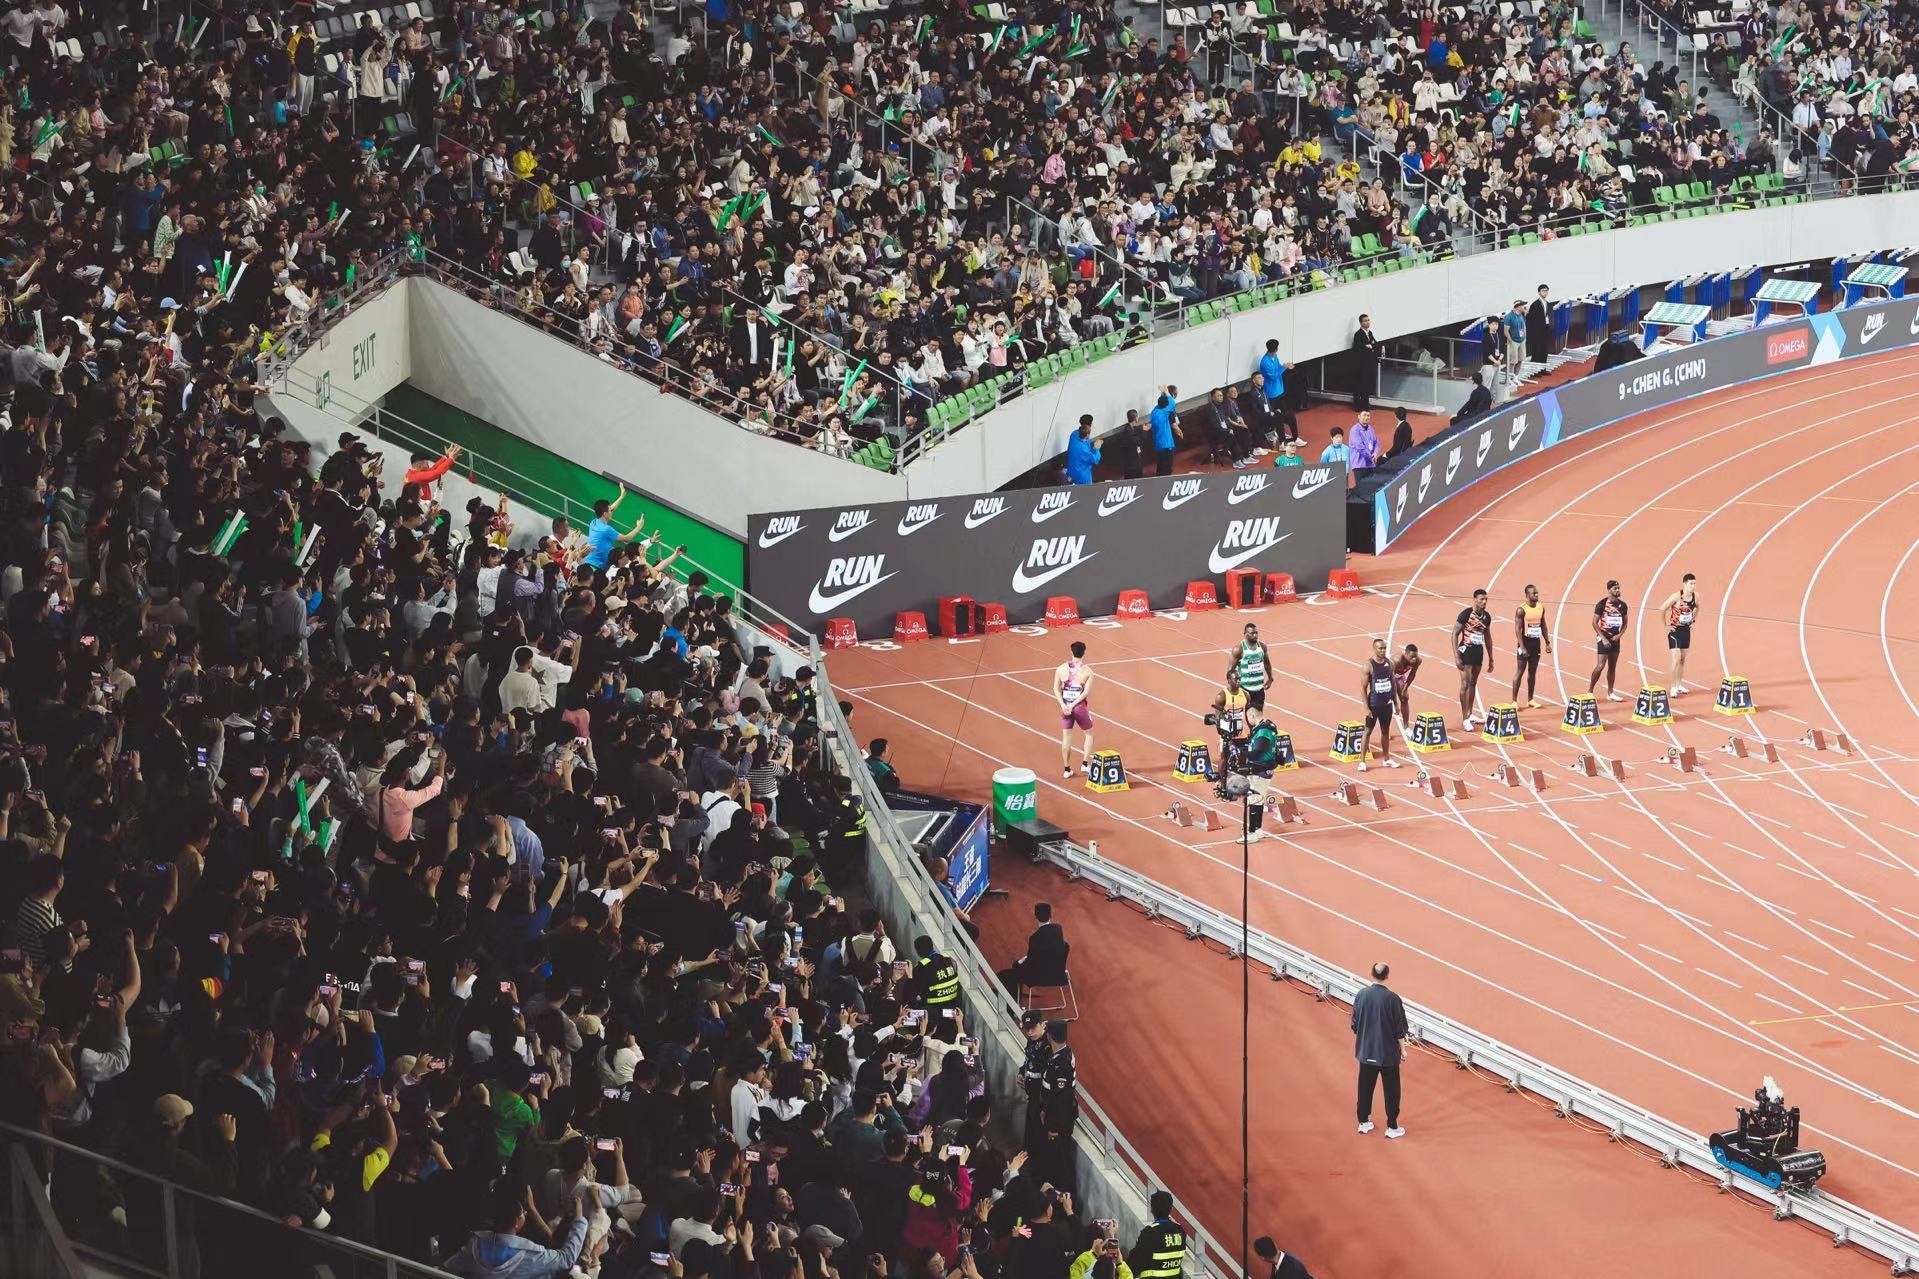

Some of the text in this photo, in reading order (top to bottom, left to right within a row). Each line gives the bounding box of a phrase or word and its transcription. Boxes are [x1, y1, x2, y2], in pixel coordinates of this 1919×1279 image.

[1865, 312, 1885, 330] RUN
[1778, 340, 1806, 354] OMEGA
[353, 332, 376, 381] EXIT
[1619, 383, 1626, 400] 9
[1633, 370, 1661, 395] CHEN
[1662, 368, 1673, 386] G.
[1675, 359, 1706, 386] (CHN)
[1512, 413, 1526, 435] RUN
[1236, 474, 1267, 490] RUN
[1300, 468, 1330, 484] RUN
[1106, 486, 1137, 503] RUN
[1171, 479, 1201, 496] RUN
[972, 497, 1005, 515] RUN
[1039, 491, 1071, 509] RUN
[836, 510, 870, 528] RUN
[906, 503, 938, 521] RUN
[767, 516, 801, 534] RUN
[1222, 516, 1281, 549] RUN
[1026, 535, 1086, 568] RUN
[824, 554, 886, 588] RUN
[1721, 691, 1727, 705] 1
[1738, 693, 1746, 707] 1
[1639, 701, 1646, 715] 2
[1656, 702, 1665, 717] 2
[1568, 709, 1576, 724] 3
[1586, 711, 1594, 725] 3
[1489, 719, 1495, 733] 4
[1505, 720, 1515, 734] 4
[1415, 727, 1423, 741] 5
[1432, 729, 1441, 743] 5
[1337, 737, 1344, 752] 6
[1353, 738, 1362, 752] 6
[1279, 747, 1288, 758] 7
[1180, 756, 1187, 772] 8
[1195, 758, 1206, 772] 8
[1093, 766, 1099, 781] 9
[1108, 768, 1118, 782] 9
[1164, 1233, 1182, 1247] 执勤
